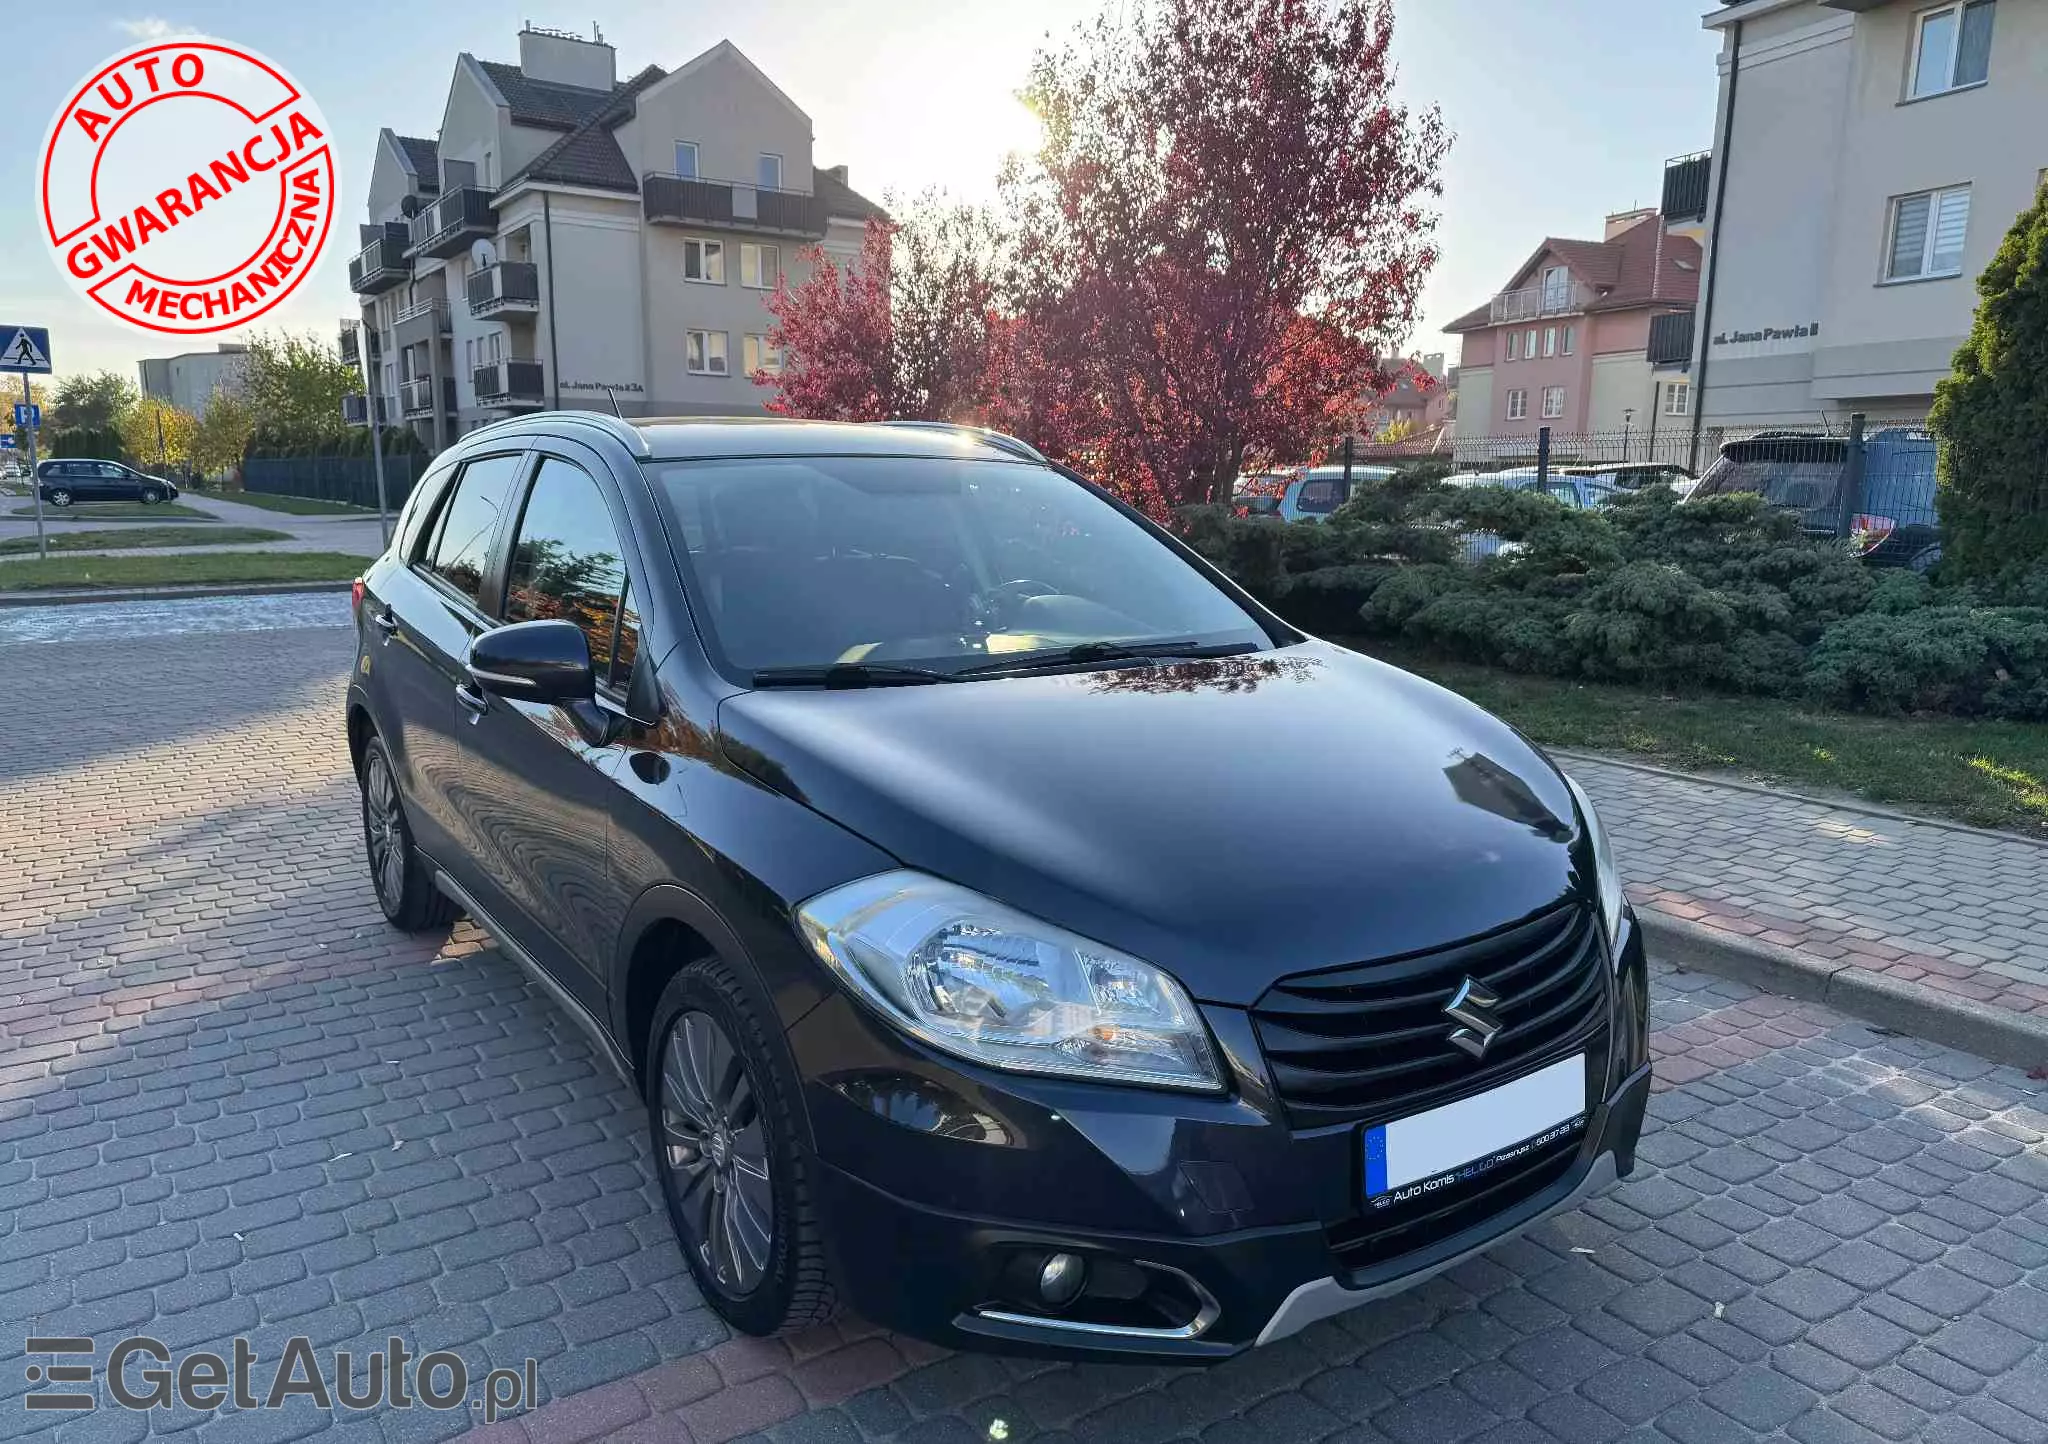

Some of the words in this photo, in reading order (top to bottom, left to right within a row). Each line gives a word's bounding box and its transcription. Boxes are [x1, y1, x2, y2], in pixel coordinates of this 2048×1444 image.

[1729, 331, 1762, 343] Jana
[571, 382, 594, 391] Jana
[1393, 1186, 1422, 1205] Auto
[1423, 1174, 1455, 1193] Komis
